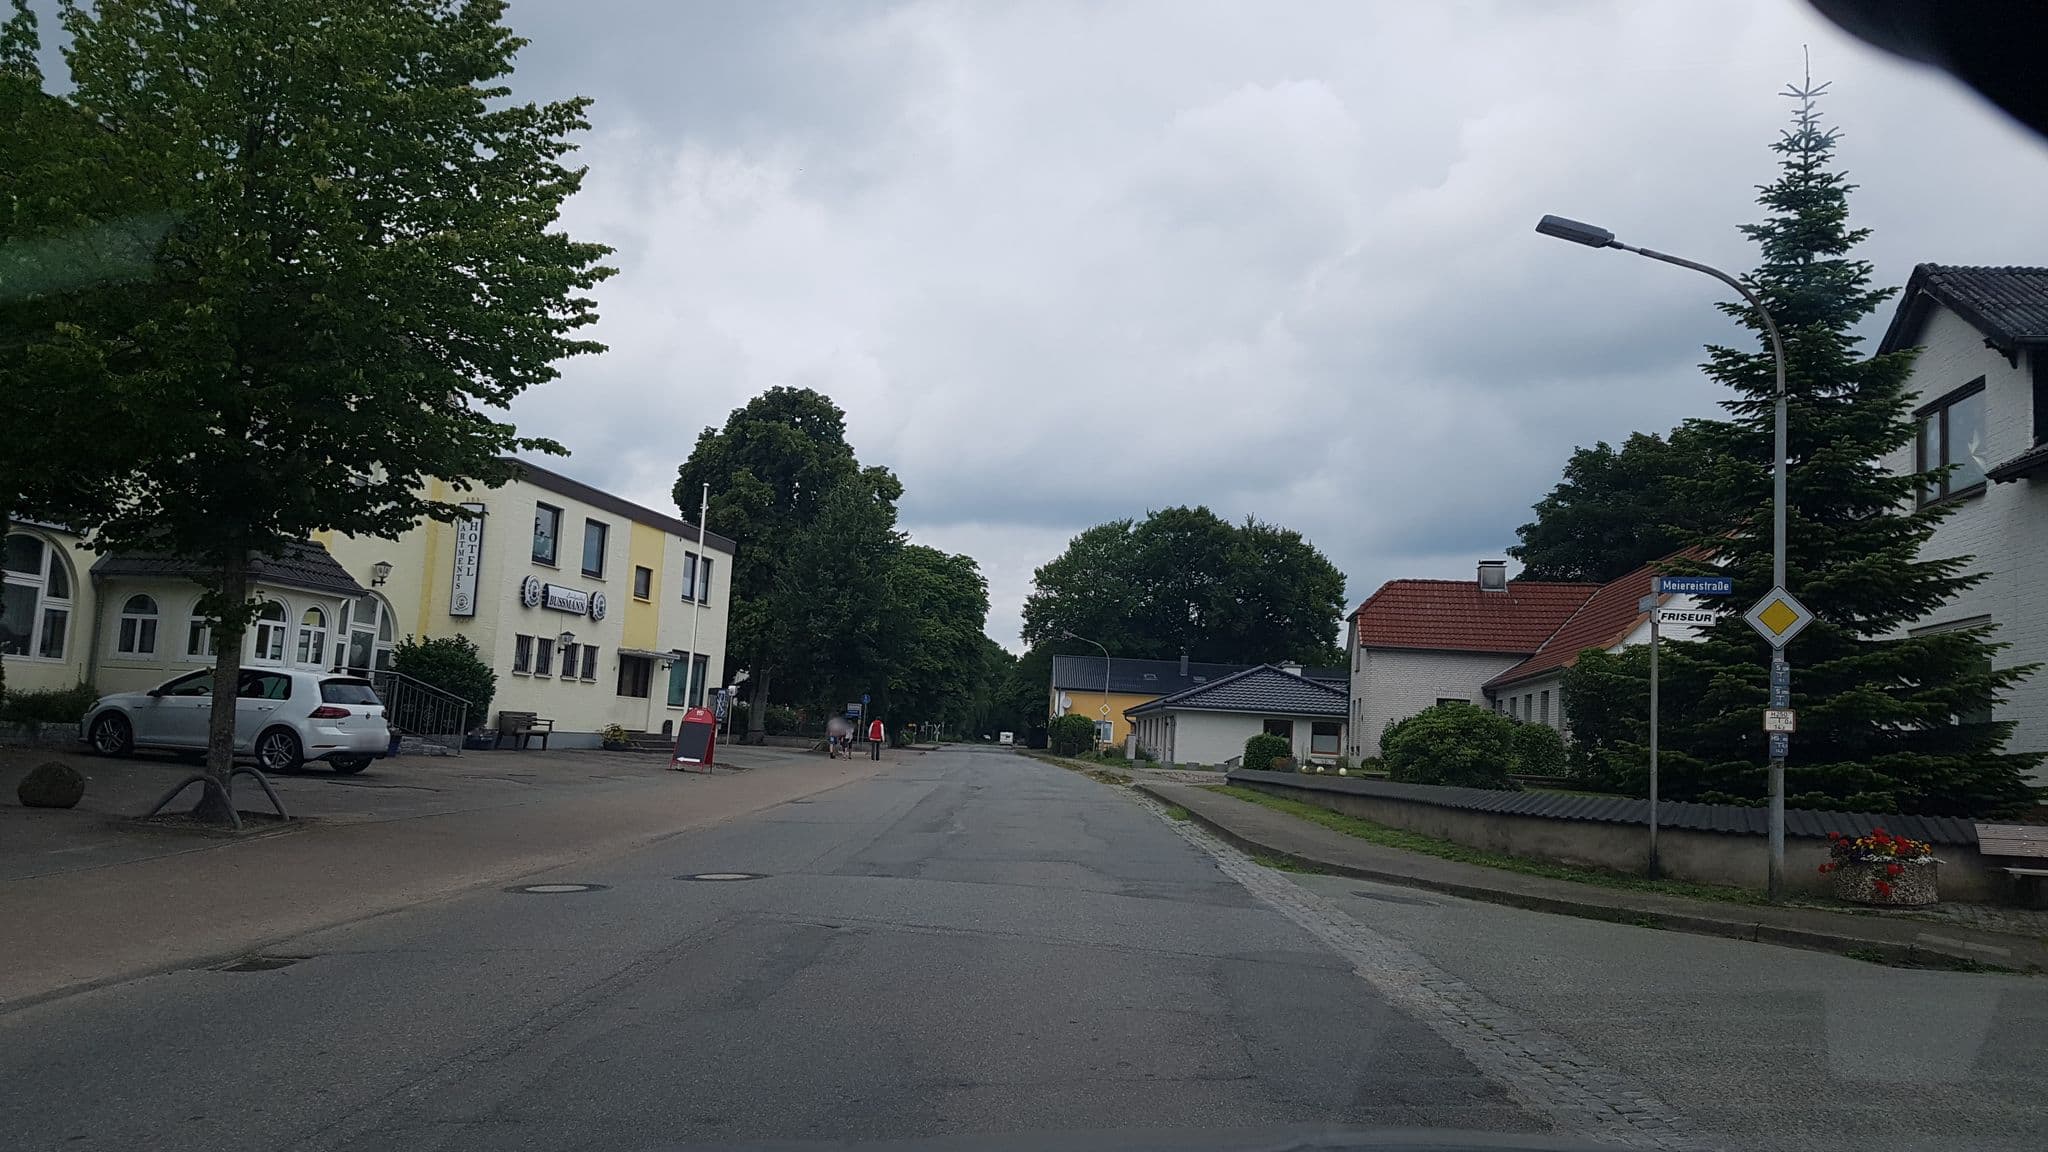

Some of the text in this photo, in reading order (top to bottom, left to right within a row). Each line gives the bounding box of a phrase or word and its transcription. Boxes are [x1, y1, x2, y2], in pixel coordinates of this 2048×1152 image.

[466, 522, 478, 577] HOTEL
[1663, 580, 1729, 591] Meiereistraße
[549, 594, 585, 612] BUSSMANN
[1661, 612, 1712, 622] FRISEUR
